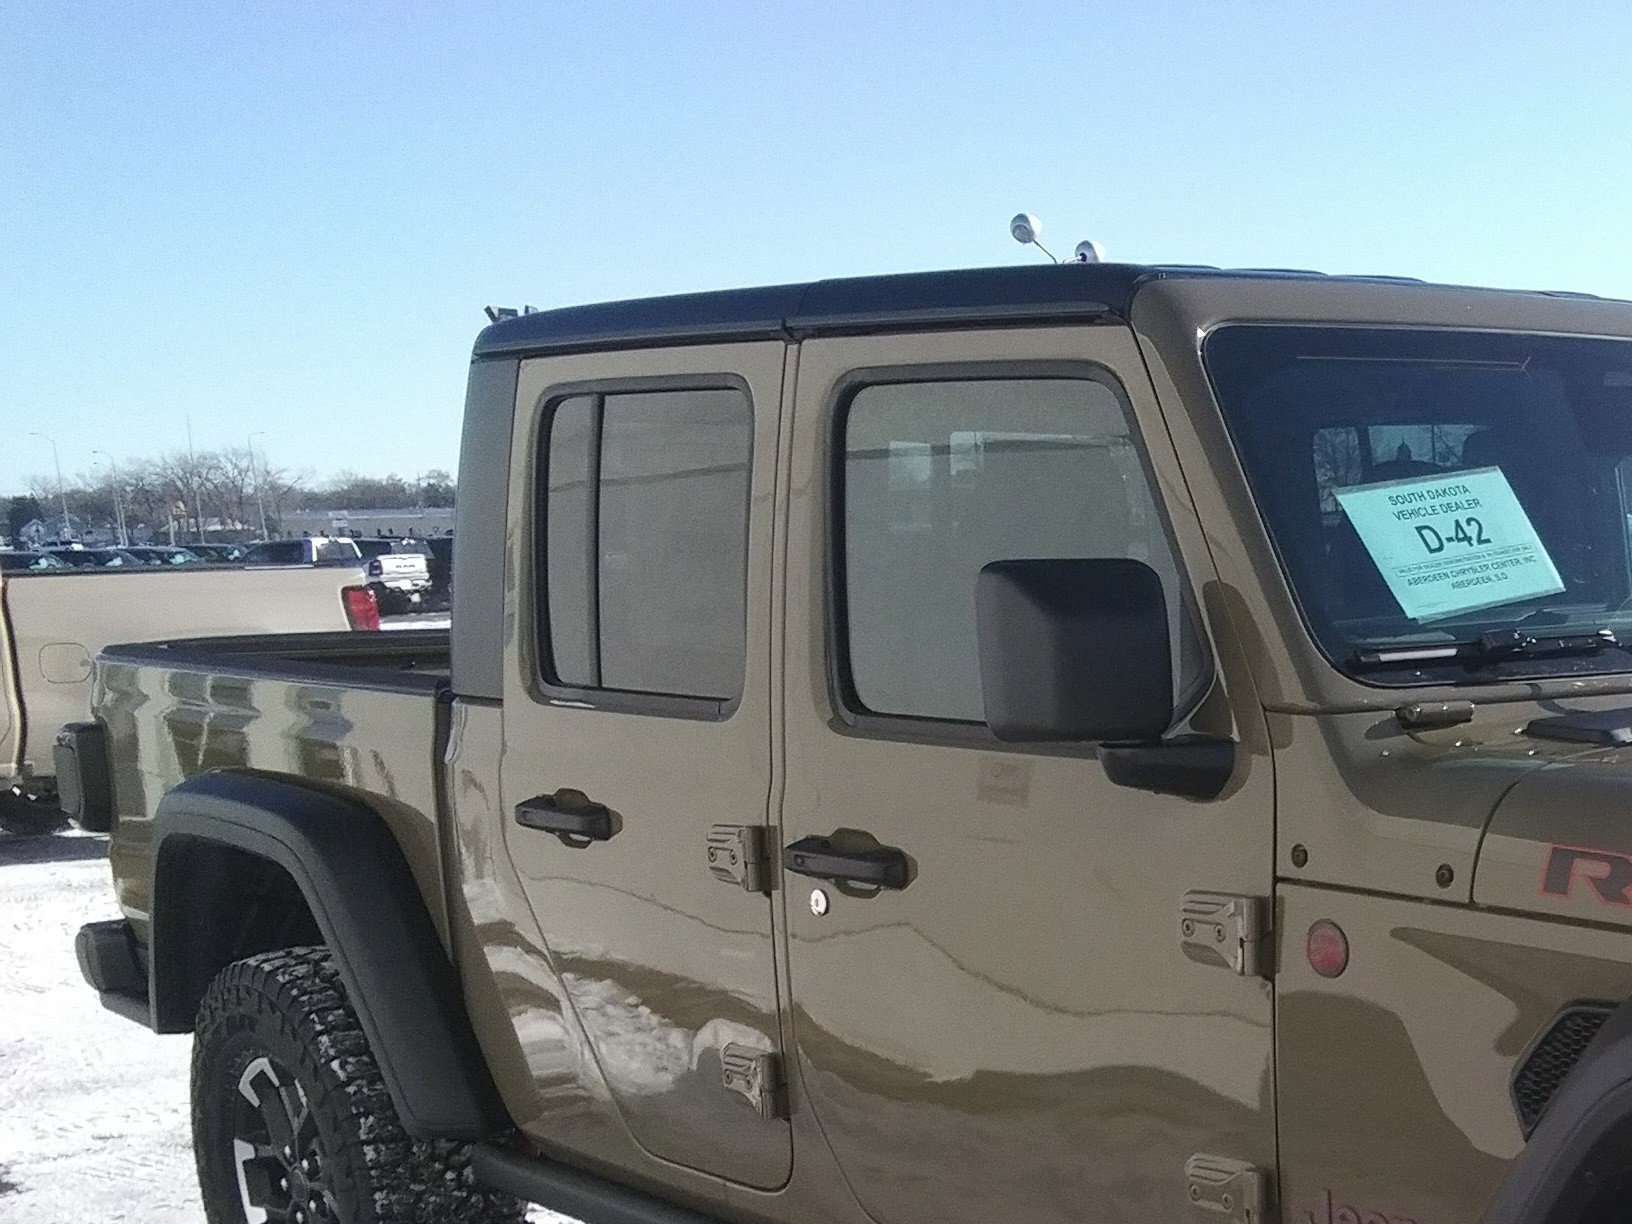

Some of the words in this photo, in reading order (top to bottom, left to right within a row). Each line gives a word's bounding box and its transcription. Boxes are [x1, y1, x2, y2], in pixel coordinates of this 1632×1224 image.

[1388, 492, 1427, 506] SOUTH
[1426, 484, 1472, 500] DAKOTA
[1392, 505, 1440, 521] VEHICLE
[1439, 498, 1482, 514] DEALER
[1414, 516, 1492, 554] D-42
[1406, 572, 1450, 587] ABERDEEN
